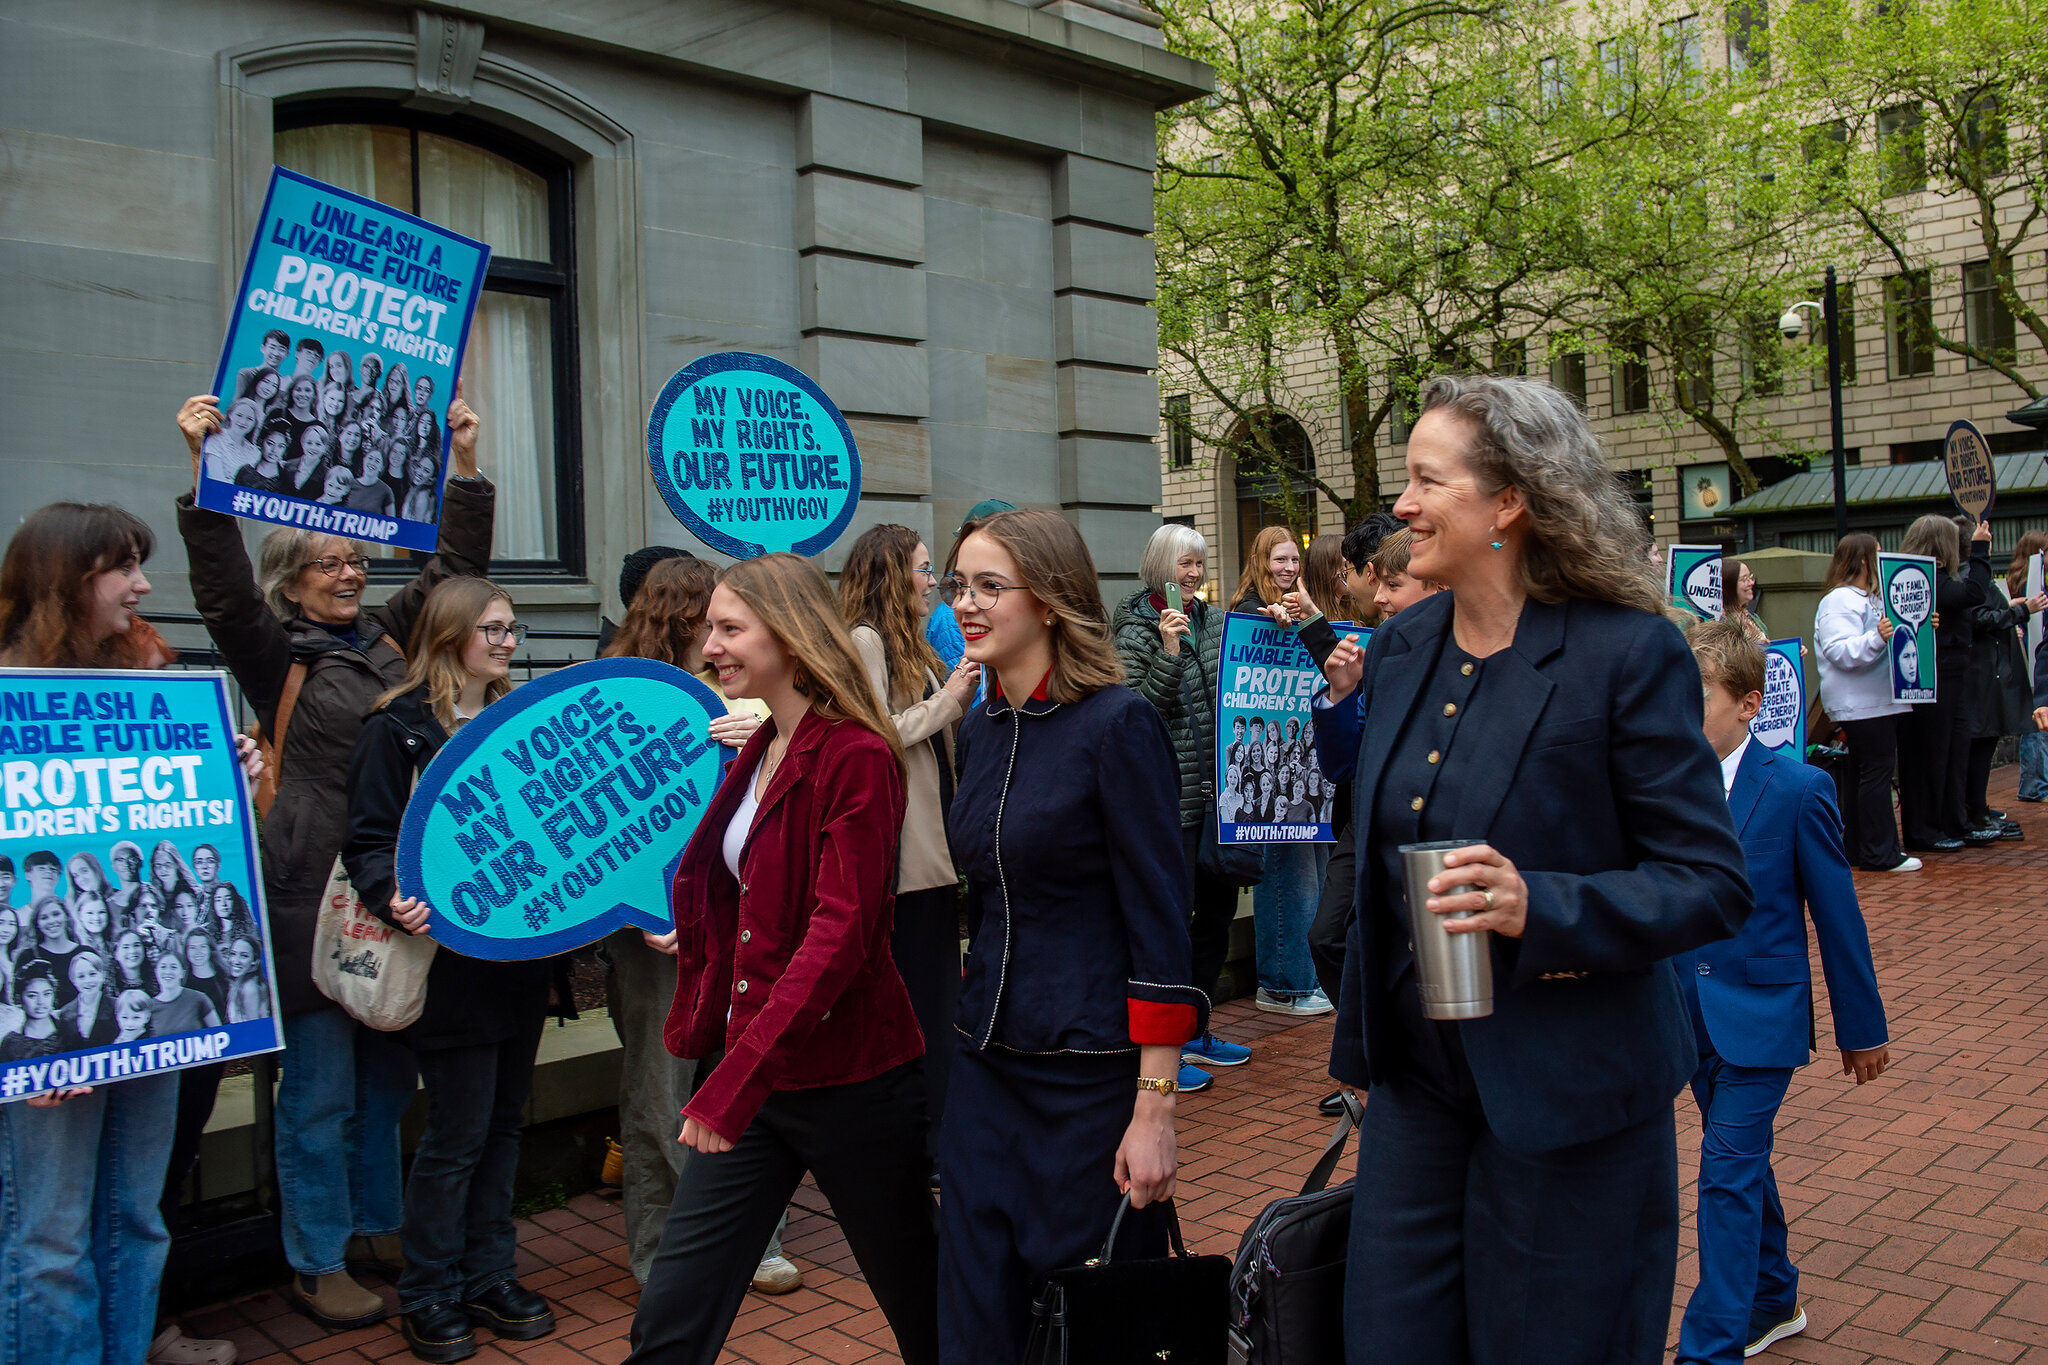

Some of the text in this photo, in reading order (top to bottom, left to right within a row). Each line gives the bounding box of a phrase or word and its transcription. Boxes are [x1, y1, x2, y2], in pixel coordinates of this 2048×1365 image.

[311, 201, 442, 269] UNLEASH A
[271, 217, 462, 302] LIVABLE FUTURE
[274, 255, 447, 339] PROTECT
[248, 288, 454, 367] CHILDREN'S RIGHTS!
[693, 385, 810, 420] MY VOICE.
[691, 418, 821, 451] MY RIGHTS.
[673, 450, 848, 491] OUR FUTURE.
[232, 490, 399, 541] #YOUTHvTRUMP
[707, 497, 828, 522] #YOUTHVGOV
[1251, 628, 1306, 649] UNLEA
[1229, 644, 1316, 668] LIVABLE FU
[1234, 666, 1329, 697] PROTEC
[1766, 680, 1790, 694] LIMATE
[1779, 669, 1786, 680] IN
[1789, 667, 1793, 679] A
[0, 692, 172, 721] NLEASH A
[1223, 692, 1312, 712] CHILDREN'S RI
[1761, 691, 1797, 708] ERGENCY!
[93, 723, 213, 752] FUTURE
[440, 686, 624, 827] MY VOICE.
[0, 755, 203, 808] ROTECT
[454, 711, 656, 866] MY RIGHTS.
[128, 799, 234, 831] RIGHTS!
[451, 716, 717, 927] OUR FUTURE.
[1235, 825, 1318, 841] #YOUTHvTRUMP
[522, 778, 702, 932] #YOUTHVGOV
[1, 1031, 230, 1097] #YOUTHvTRUMP
